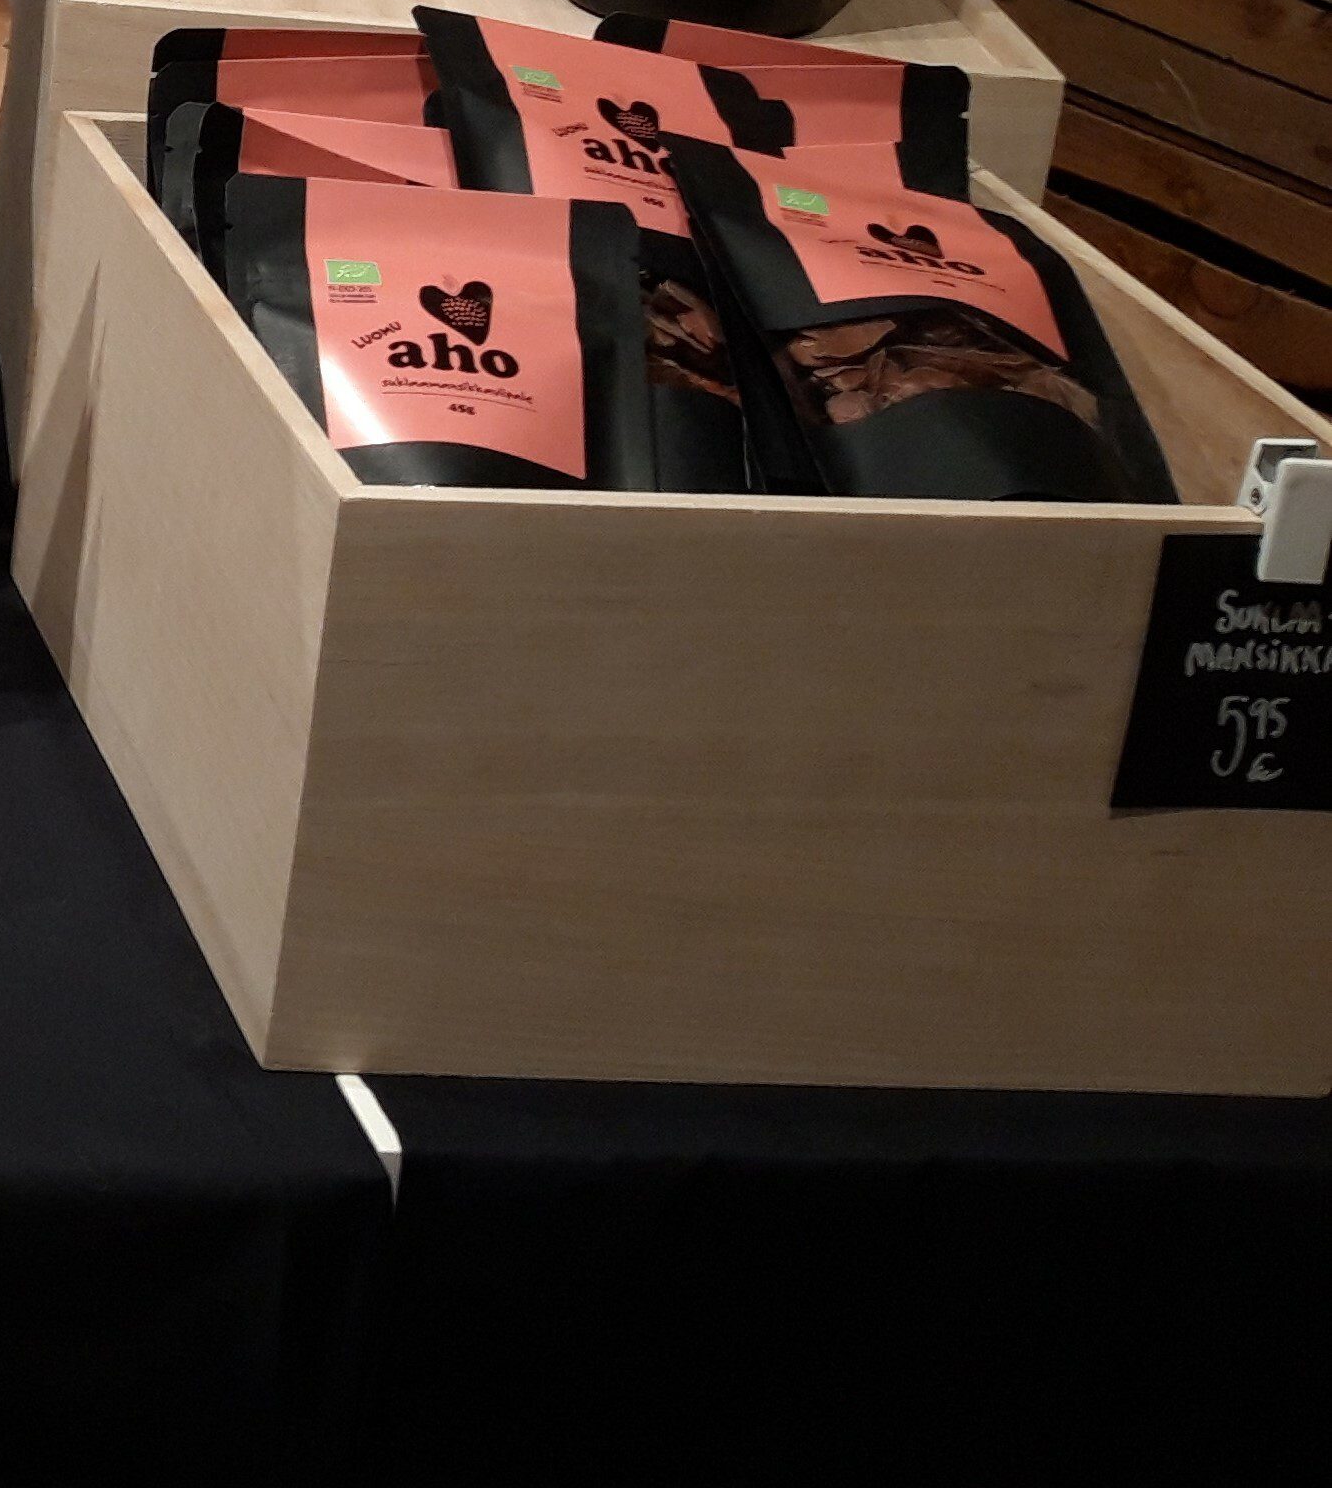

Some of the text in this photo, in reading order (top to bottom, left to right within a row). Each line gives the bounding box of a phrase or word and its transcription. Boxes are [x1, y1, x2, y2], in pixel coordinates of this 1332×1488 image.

[581, 138, 675, 176] ah
[855, 246, 987, 276] aho
[350, 321, 402, 350] LUOMU
[388, 332, 519, 379] aho
